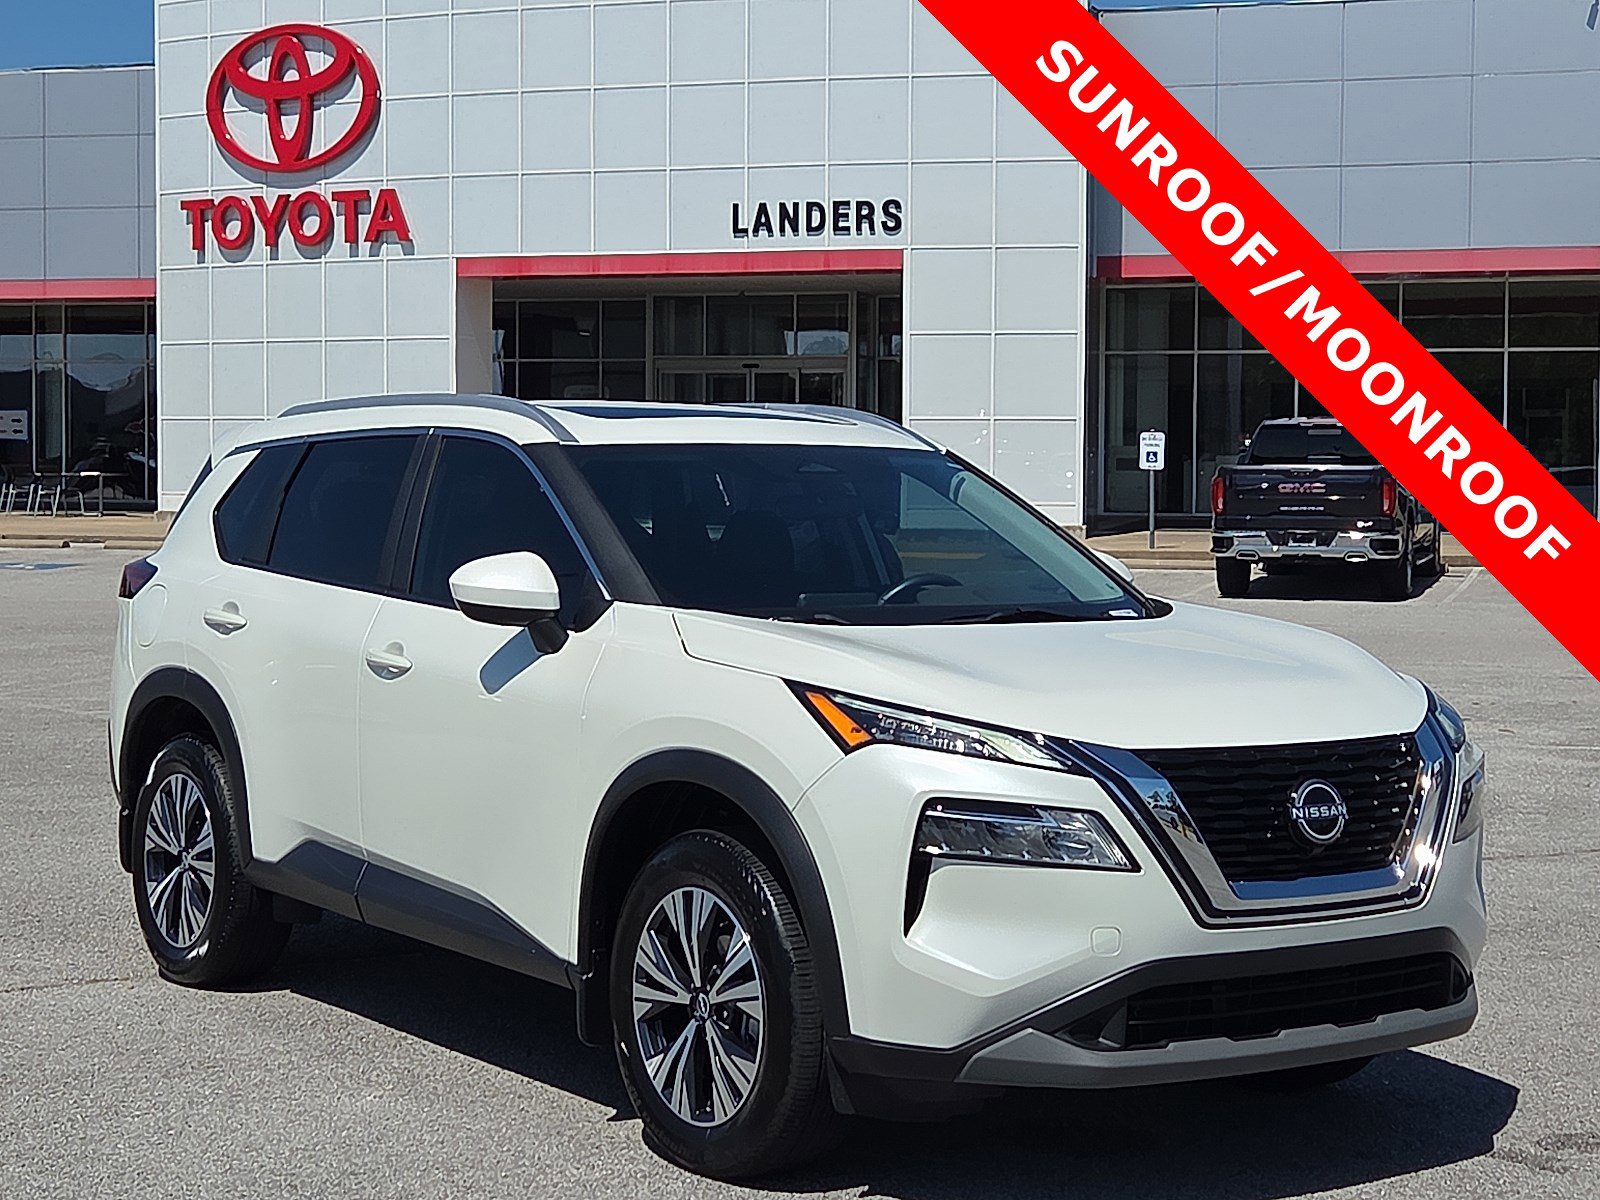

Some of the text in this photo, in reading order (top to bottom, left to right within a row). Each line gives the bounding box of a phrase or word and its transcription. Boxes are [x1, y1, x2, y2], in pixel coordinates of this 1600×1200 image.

[180, 188, 411, 251] TOYOTA
[732, 199, 902, 238] LANDERS
[1278, 482, 1326, 493] GMC
[1292, 802, 1349, 819] NISSAN
